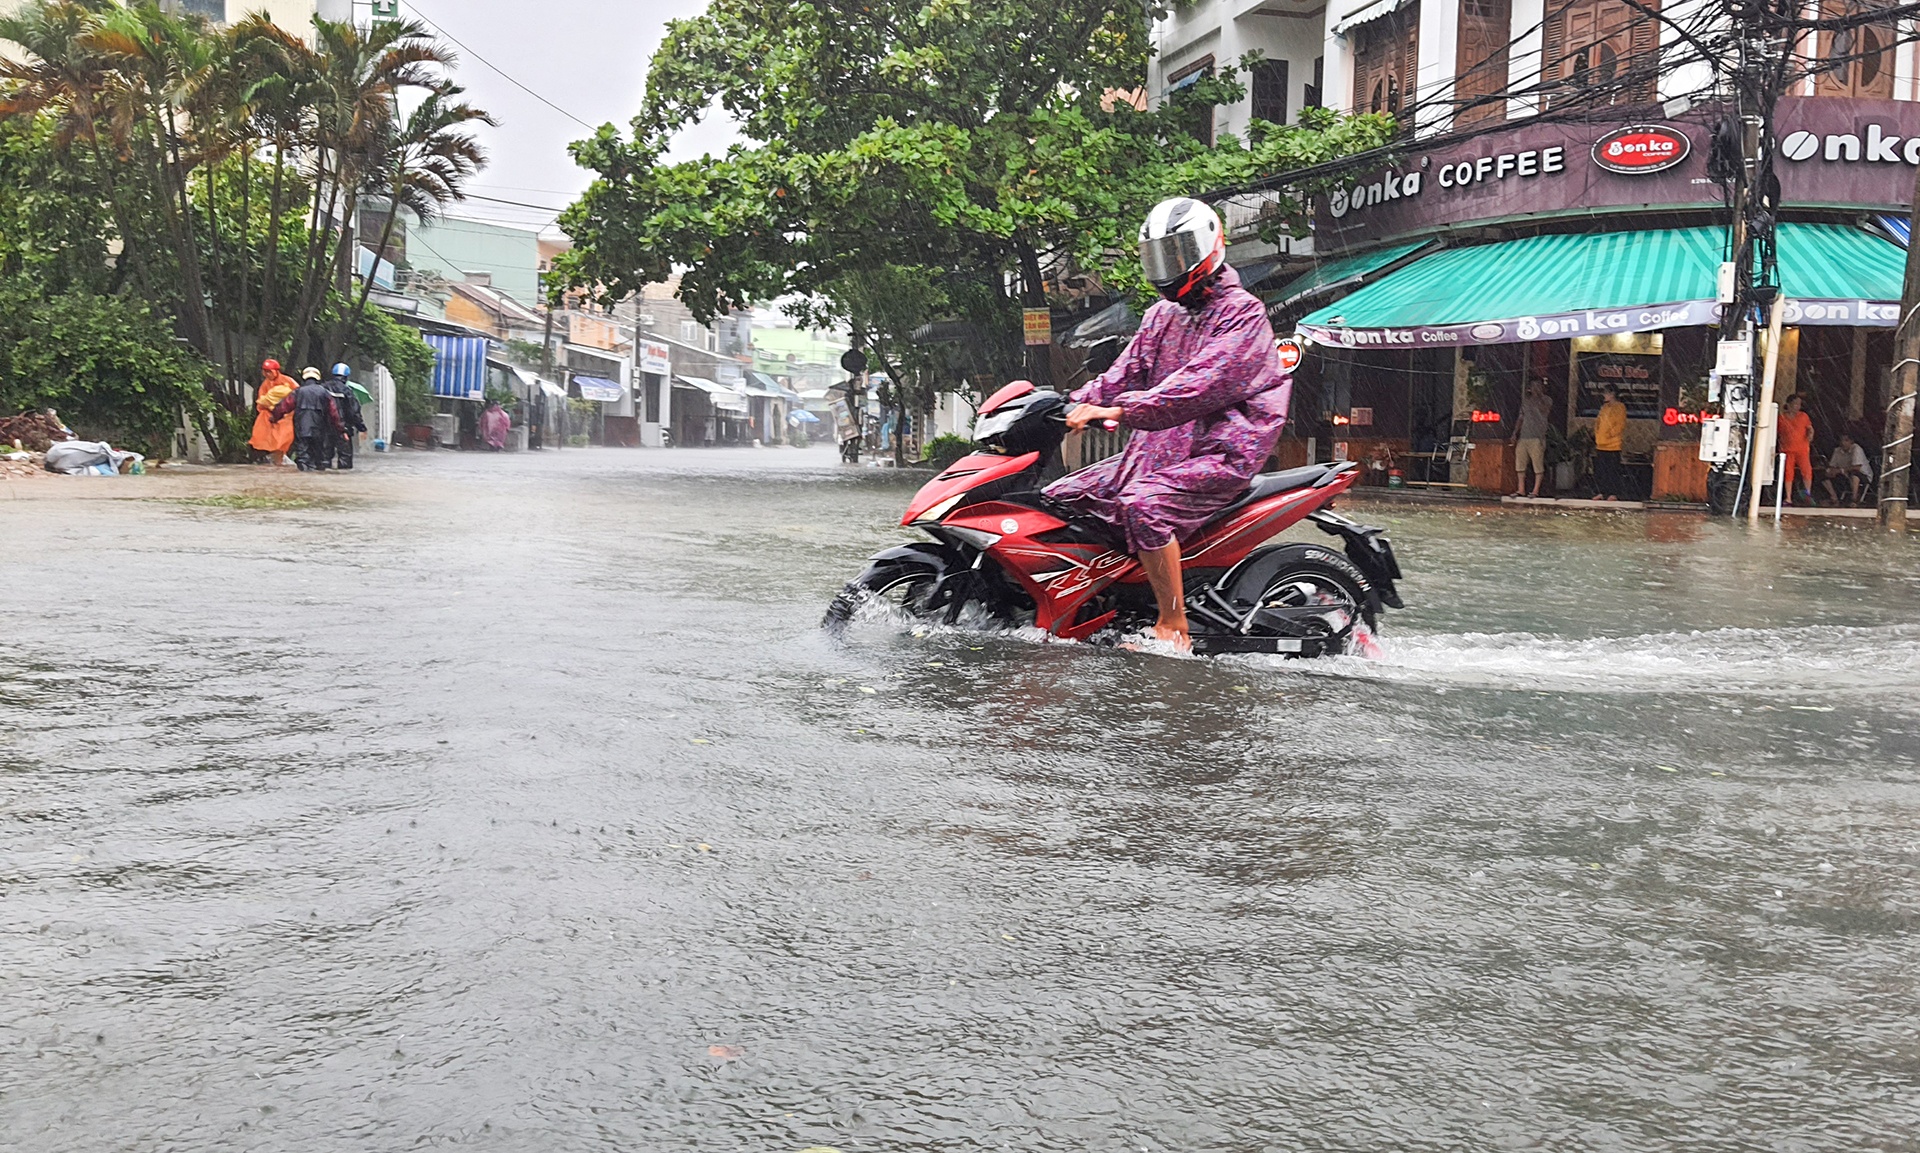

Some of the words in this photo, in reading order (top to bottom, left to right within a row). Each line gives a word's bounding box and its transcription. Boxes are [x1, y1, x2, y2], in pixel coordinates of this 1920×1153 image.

[1764, 124, 1920, 165] onk
[1438, 146, 1564, 188] COFFEE
[1639, 309, 1689, 325] Coffee
[1421, 331, 1458, 342] Coffee
